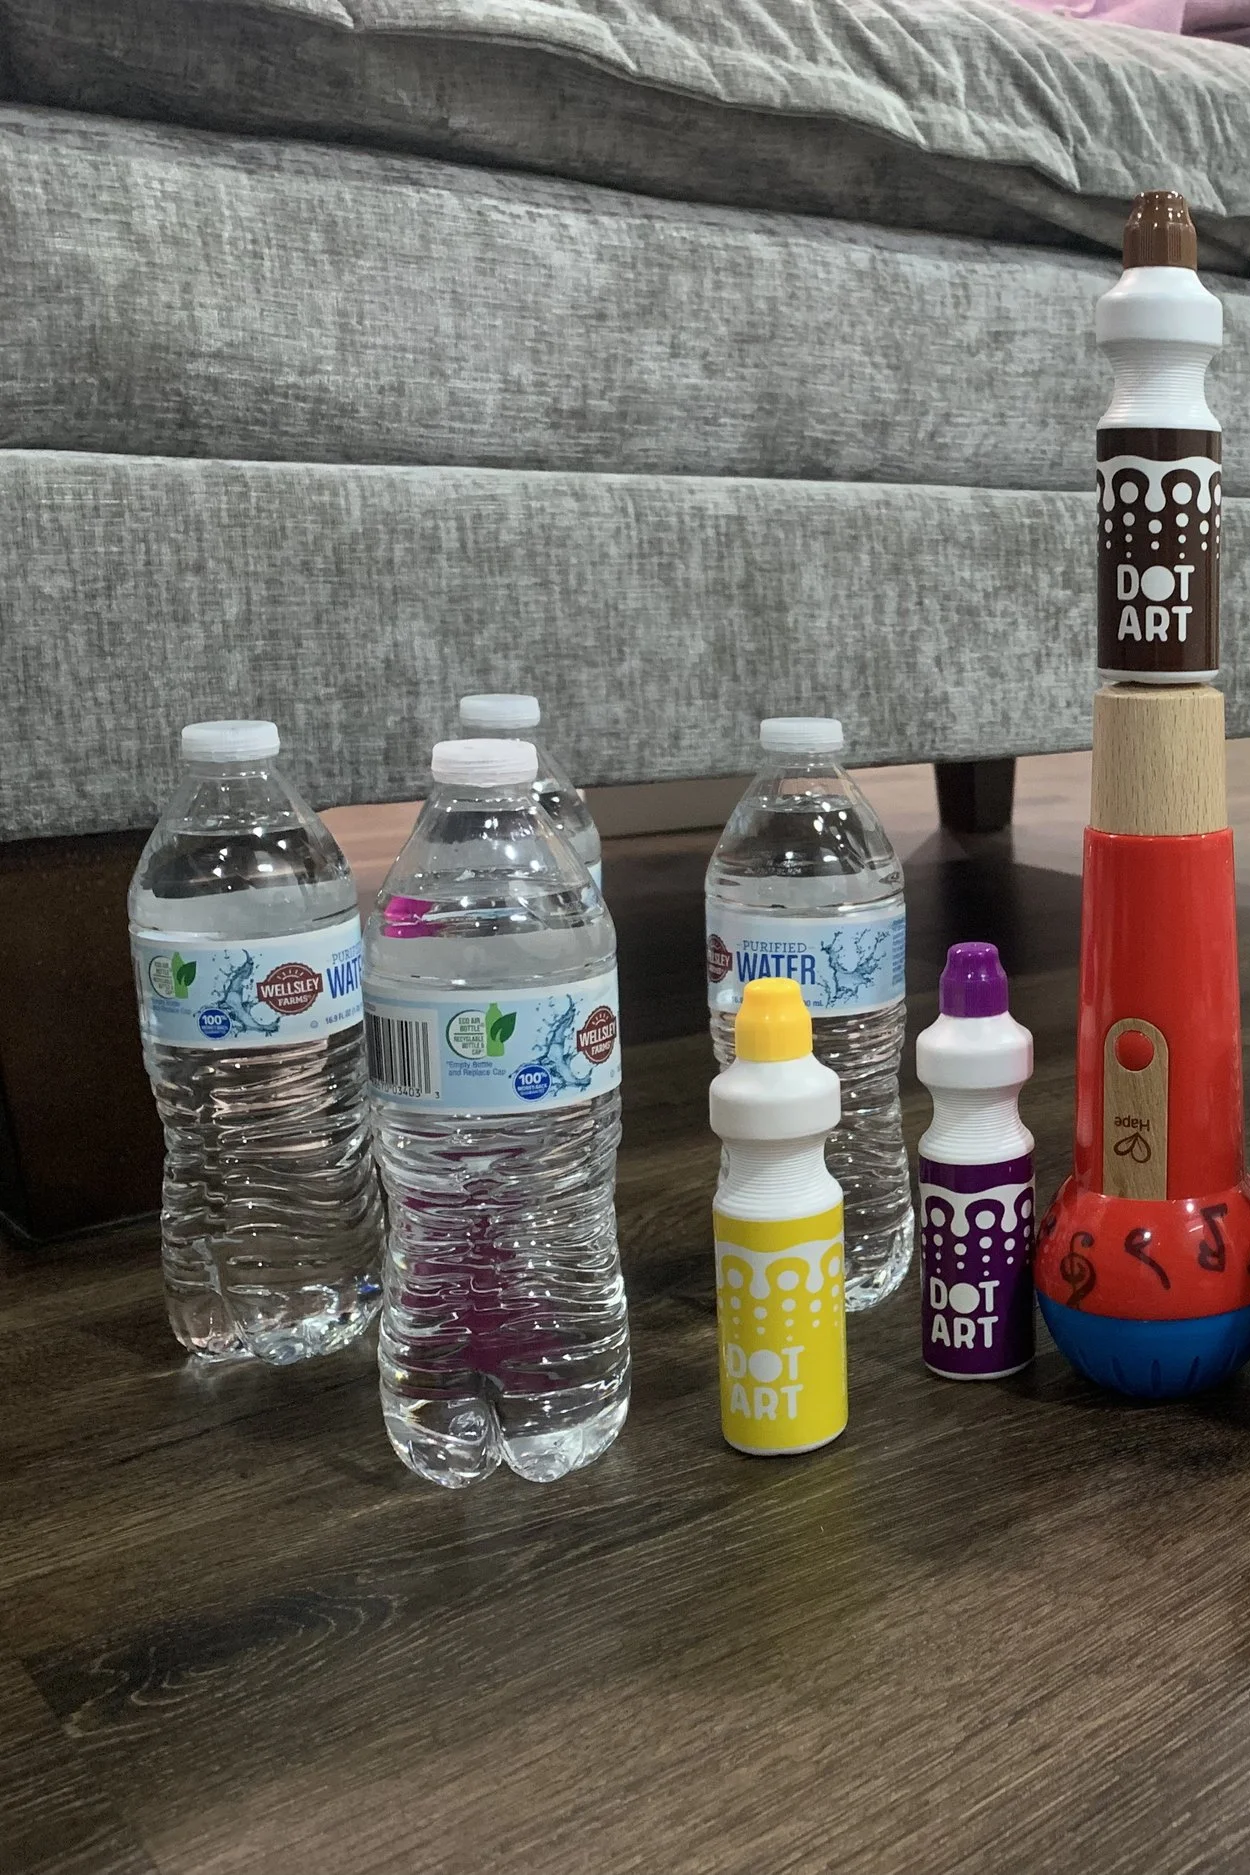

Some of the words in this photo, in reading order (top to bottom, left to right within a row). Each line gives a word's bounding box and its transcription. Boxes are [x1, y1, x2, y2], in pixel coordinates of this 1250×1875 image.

[1117, 564, 1195, 601] DOT
[1117, 605, 1193, 642] ART
[743, 940, 807, 953] PURIFIED
[736, 951, 816, 985] WATER
[260, 977, 319, 998] WELLSLEY
[463, 1069, 490, 1077] Replace
[492, 1068, 507, 1076] Cap
[518, 1072, 548, 1085] 100%
[393, 1086, 421, 1098] 03403
[1114, 1115, 1150, 1132] Hape
[929, 1276, 1000, 1315] DOT
[931, 1314, 999, 1349] ART
[725, 1343, 805, 1384] DOT
[729, 1383, 804, 1421] ART
